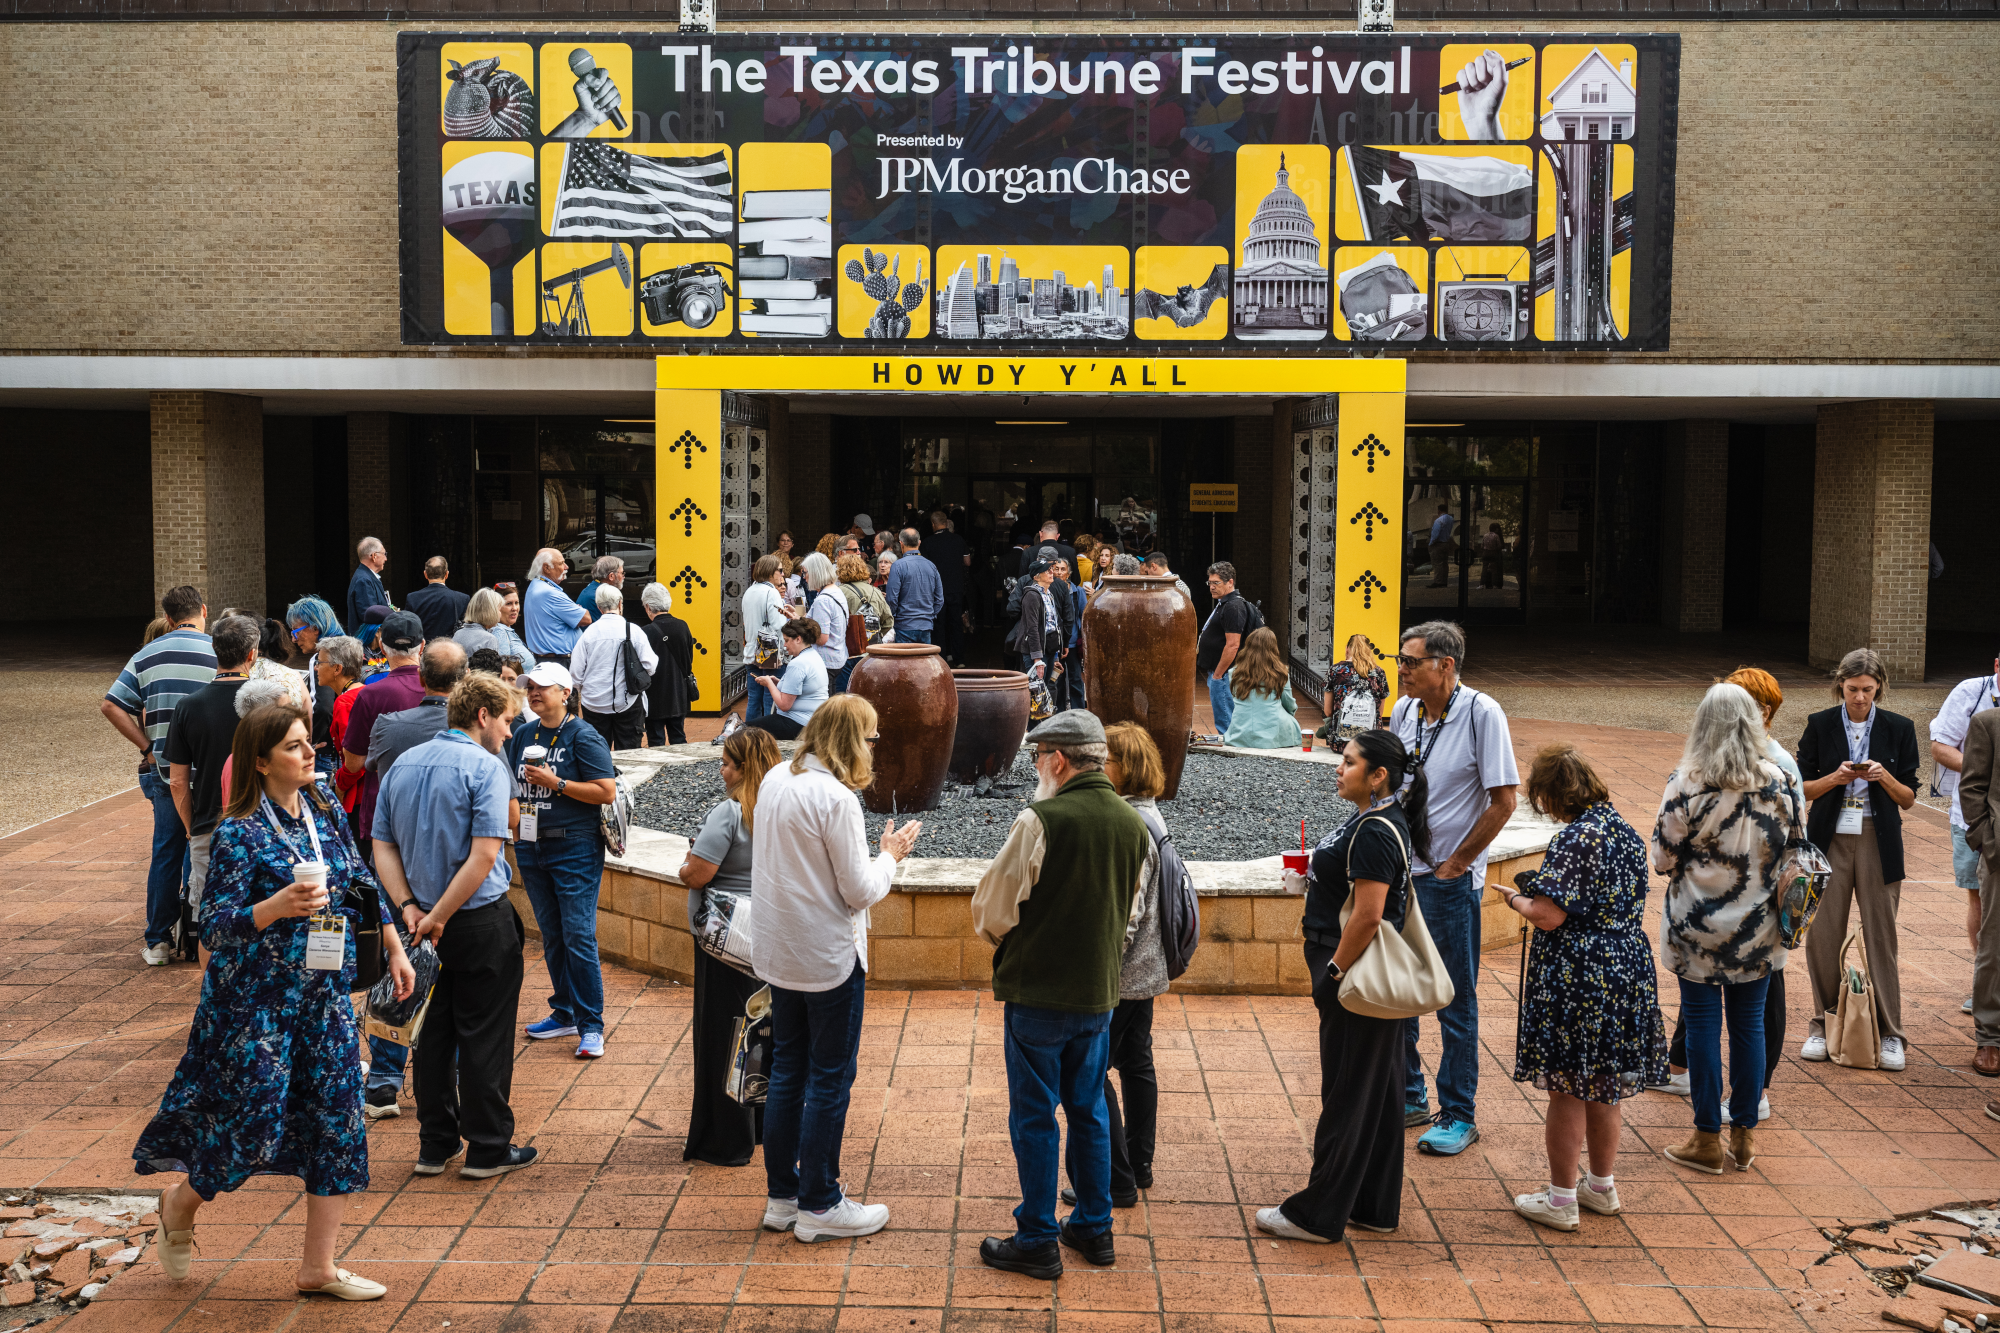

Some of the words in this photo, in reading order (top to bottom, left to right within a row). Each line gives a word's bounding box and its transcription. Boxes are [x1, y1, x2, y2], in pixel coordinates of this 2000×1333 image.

[661, 44, 768, 94] The
[779, 46, 941, 95] Texas
[951, 45, 1162, 95] Tribune
[1181, 45, 1412, 95] Festival
[876, 133, 944, 148] Presented
[946, 133, 964, 149] by
[448, 180, 536, 209] TEXAS
[875, 156, 1192, 204] JPMorganChase
[873, 362, 1026, 386] HOWDY
[1059, 363, 1187, 386] Y'ALL
